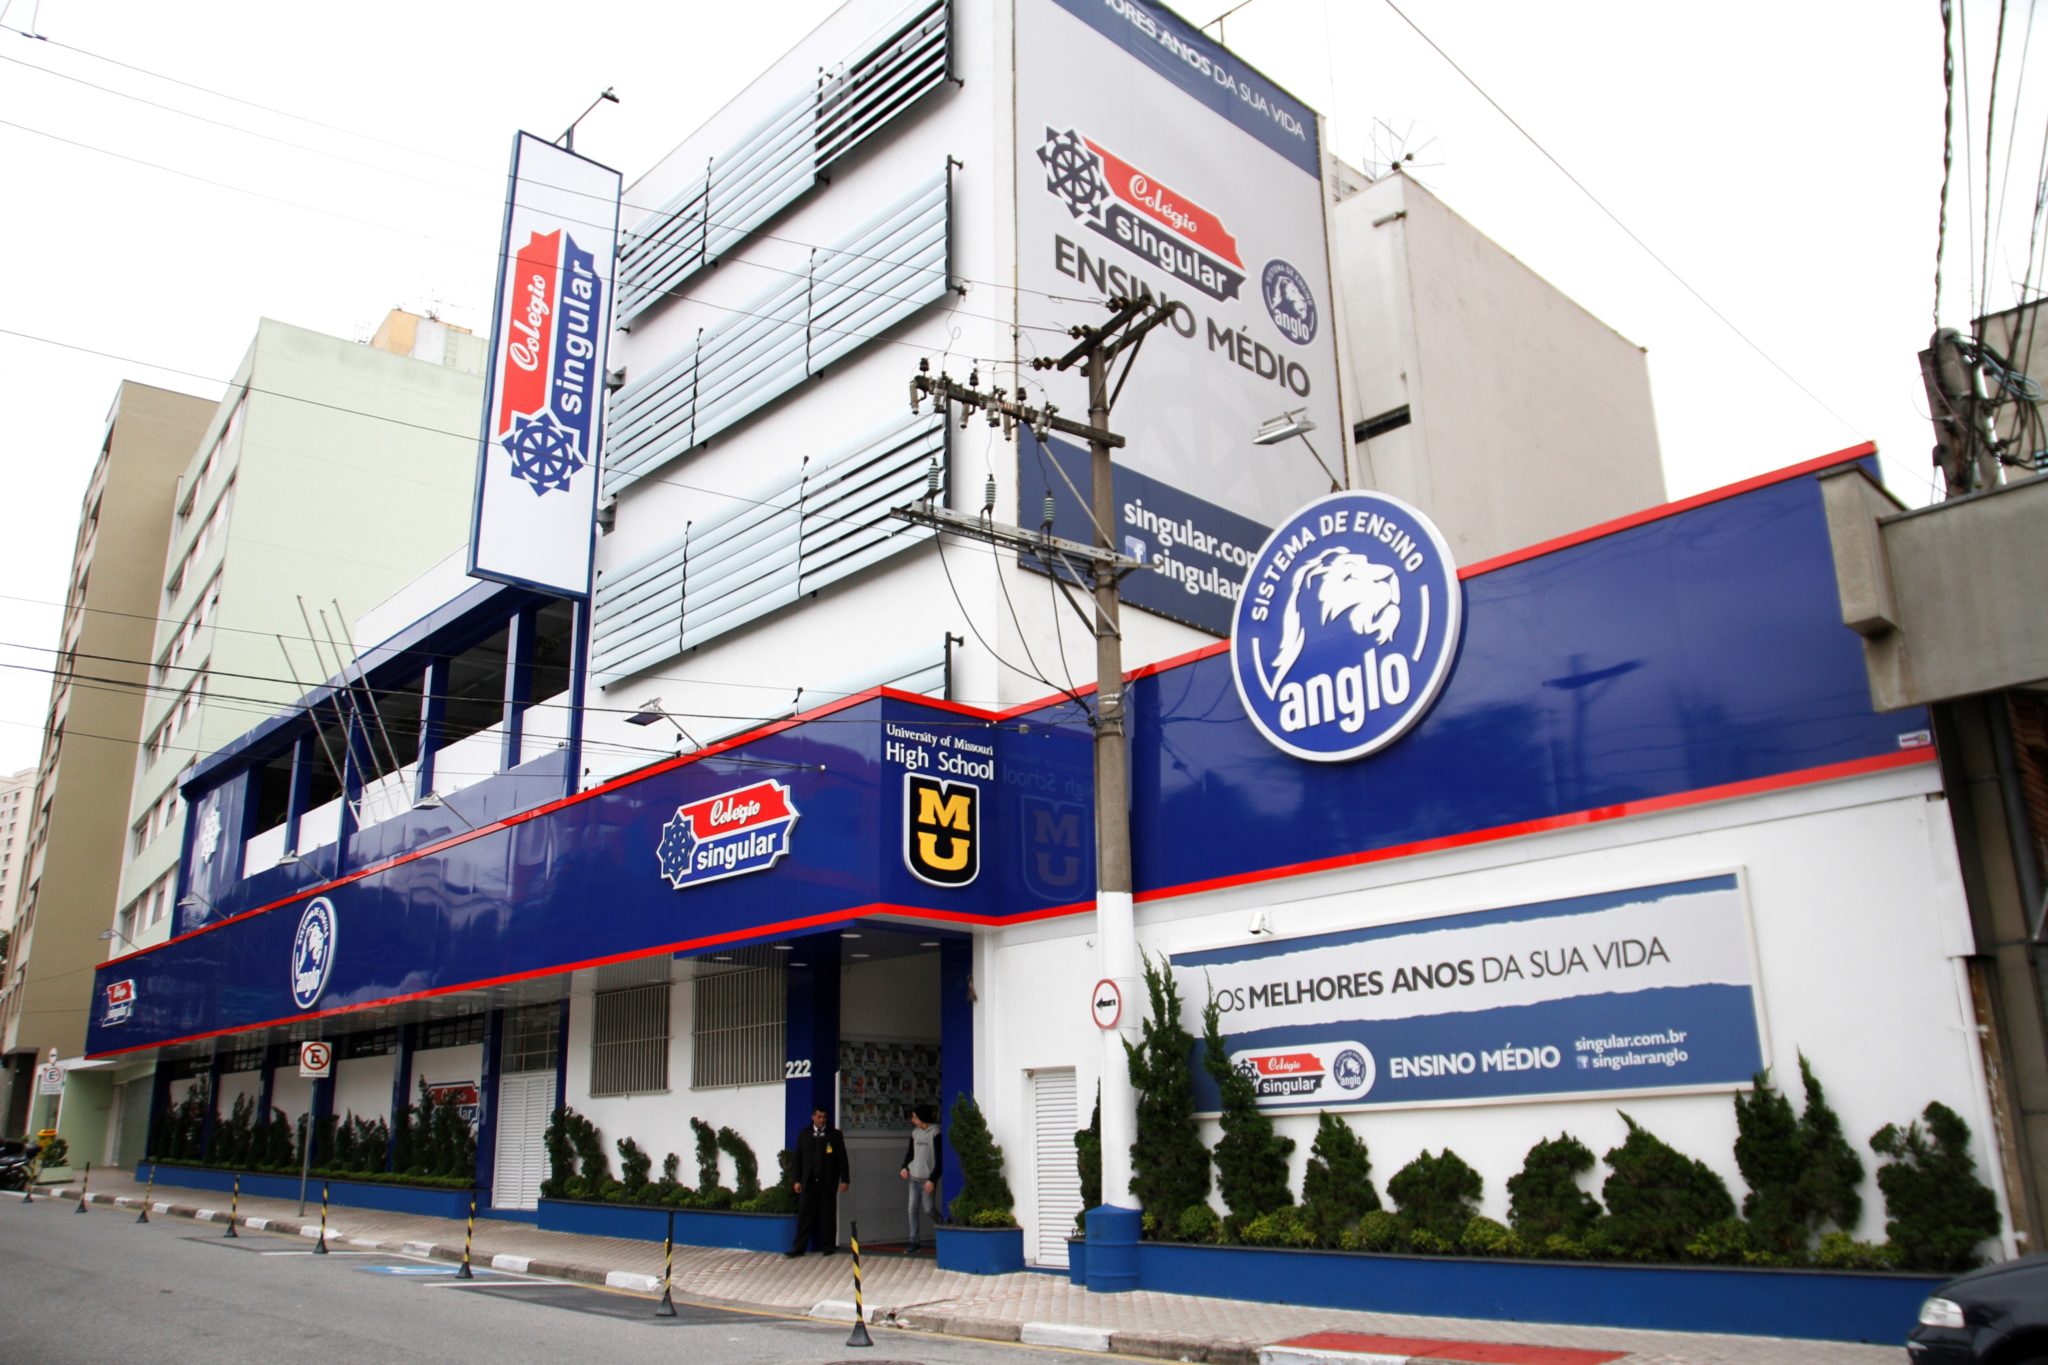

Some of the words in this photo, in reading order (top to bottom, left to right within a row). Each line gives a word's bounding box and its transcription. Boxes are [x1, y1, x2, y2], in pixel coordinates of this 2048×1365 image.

[1160, 30, 1211, 76] ANOS
[1213, 65, 1238, 96] DA
[1239, 83, 1268, 117] SUA
[1270, 103, 1306, 141] VIDA
[1129, 174, 1197, 233] Colégio
[1116, 214, 1227, 293] singular
[510, 274, 550, 371] Colégio
[556, 260, 594, 415] singular
[1274, 308, 1310, 341] anglo
[1207, 317, 1311, 397] MÉDIO
[1252, 527, 1317, 622] SISTEMA
[1319, 510, 1350, 537] DE
[1353, 510, 1424, 572] ENSINO
[1279, 647, 1411, 734] anglo
[886, 723, 938, 748] University
[940, 735, 952, 747] of
[954, 737, 994, 756] Missouri
[886, 740, 929, 770] High
[938, 751, 994, 781] School
[710, 796, 761, 827] Colégio
[696, 831, 778, 871] singular
[1216, 987, 1245, 1013] OS
[1250, 970, 1384, 1009] MELHORES
[1391, 960, 1475, 994] ANOS
[1482, 954, 1524, 984] DA
[1530, 947, 1589, 979] SUA
[1593, 936, 1671, 970] VIDA
[1390, 1052, 1476, 1079] ENSINO
[1481, 1041, 1561, 1073] MÉDIO
[1575, 1028, 1688, 1054] singular.com.br
[1592, 1047, 1689, 1071] singularanglo
[785, 1059, 812, 1079] 222
[1262, 1077, 1317, 1095] singular
[1340, 1075, 1362, 1088] anglo
